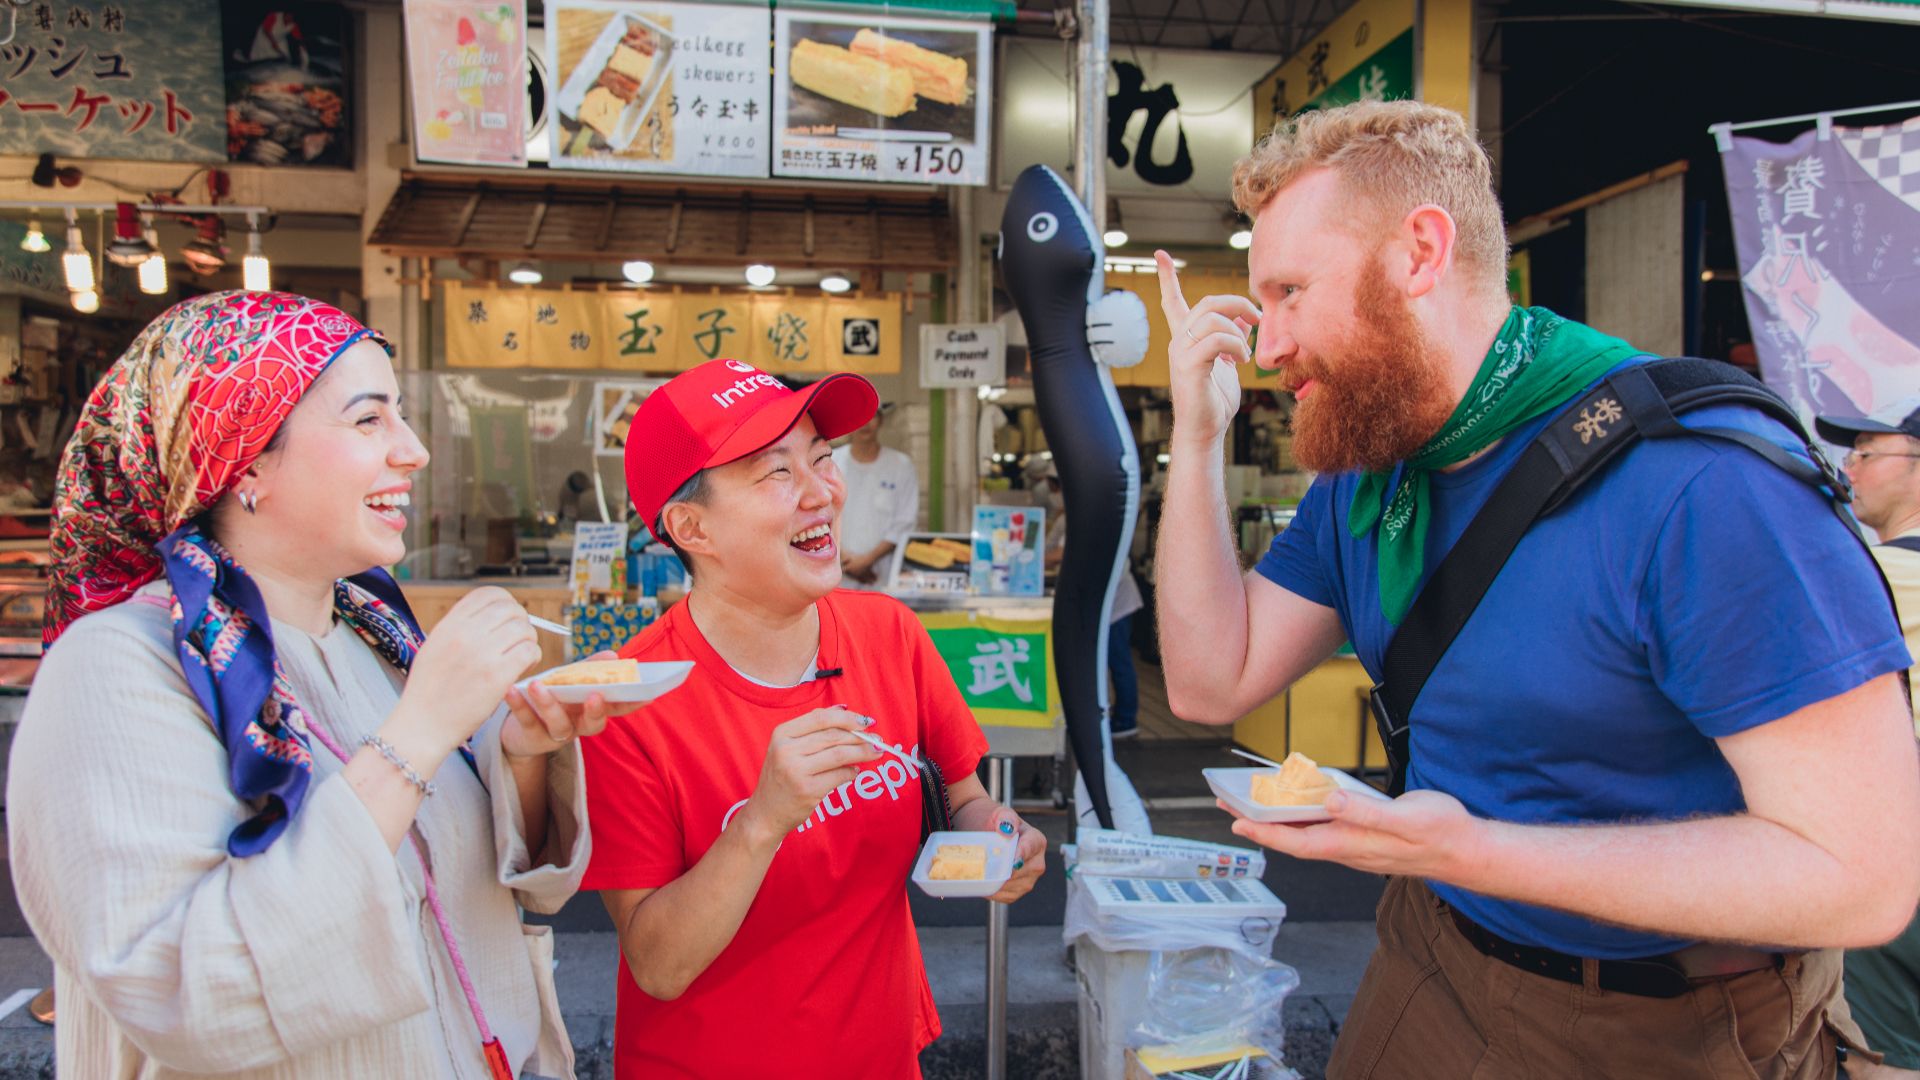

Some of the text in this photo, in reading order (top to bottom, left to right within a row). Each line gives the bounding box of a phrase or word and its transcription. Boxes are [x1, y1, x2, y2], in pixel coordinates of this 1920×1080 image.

[683, 64, 756, 84] skewers
[895, 145, 964, 174] ¥150
[850, 324, 872, 348] 武
[947, 330, 978, 342] Cash
[935, 349, 989, 362] Payment
[948, 366, 976, 379] Only
[967, 638, 1033, 703] 武
